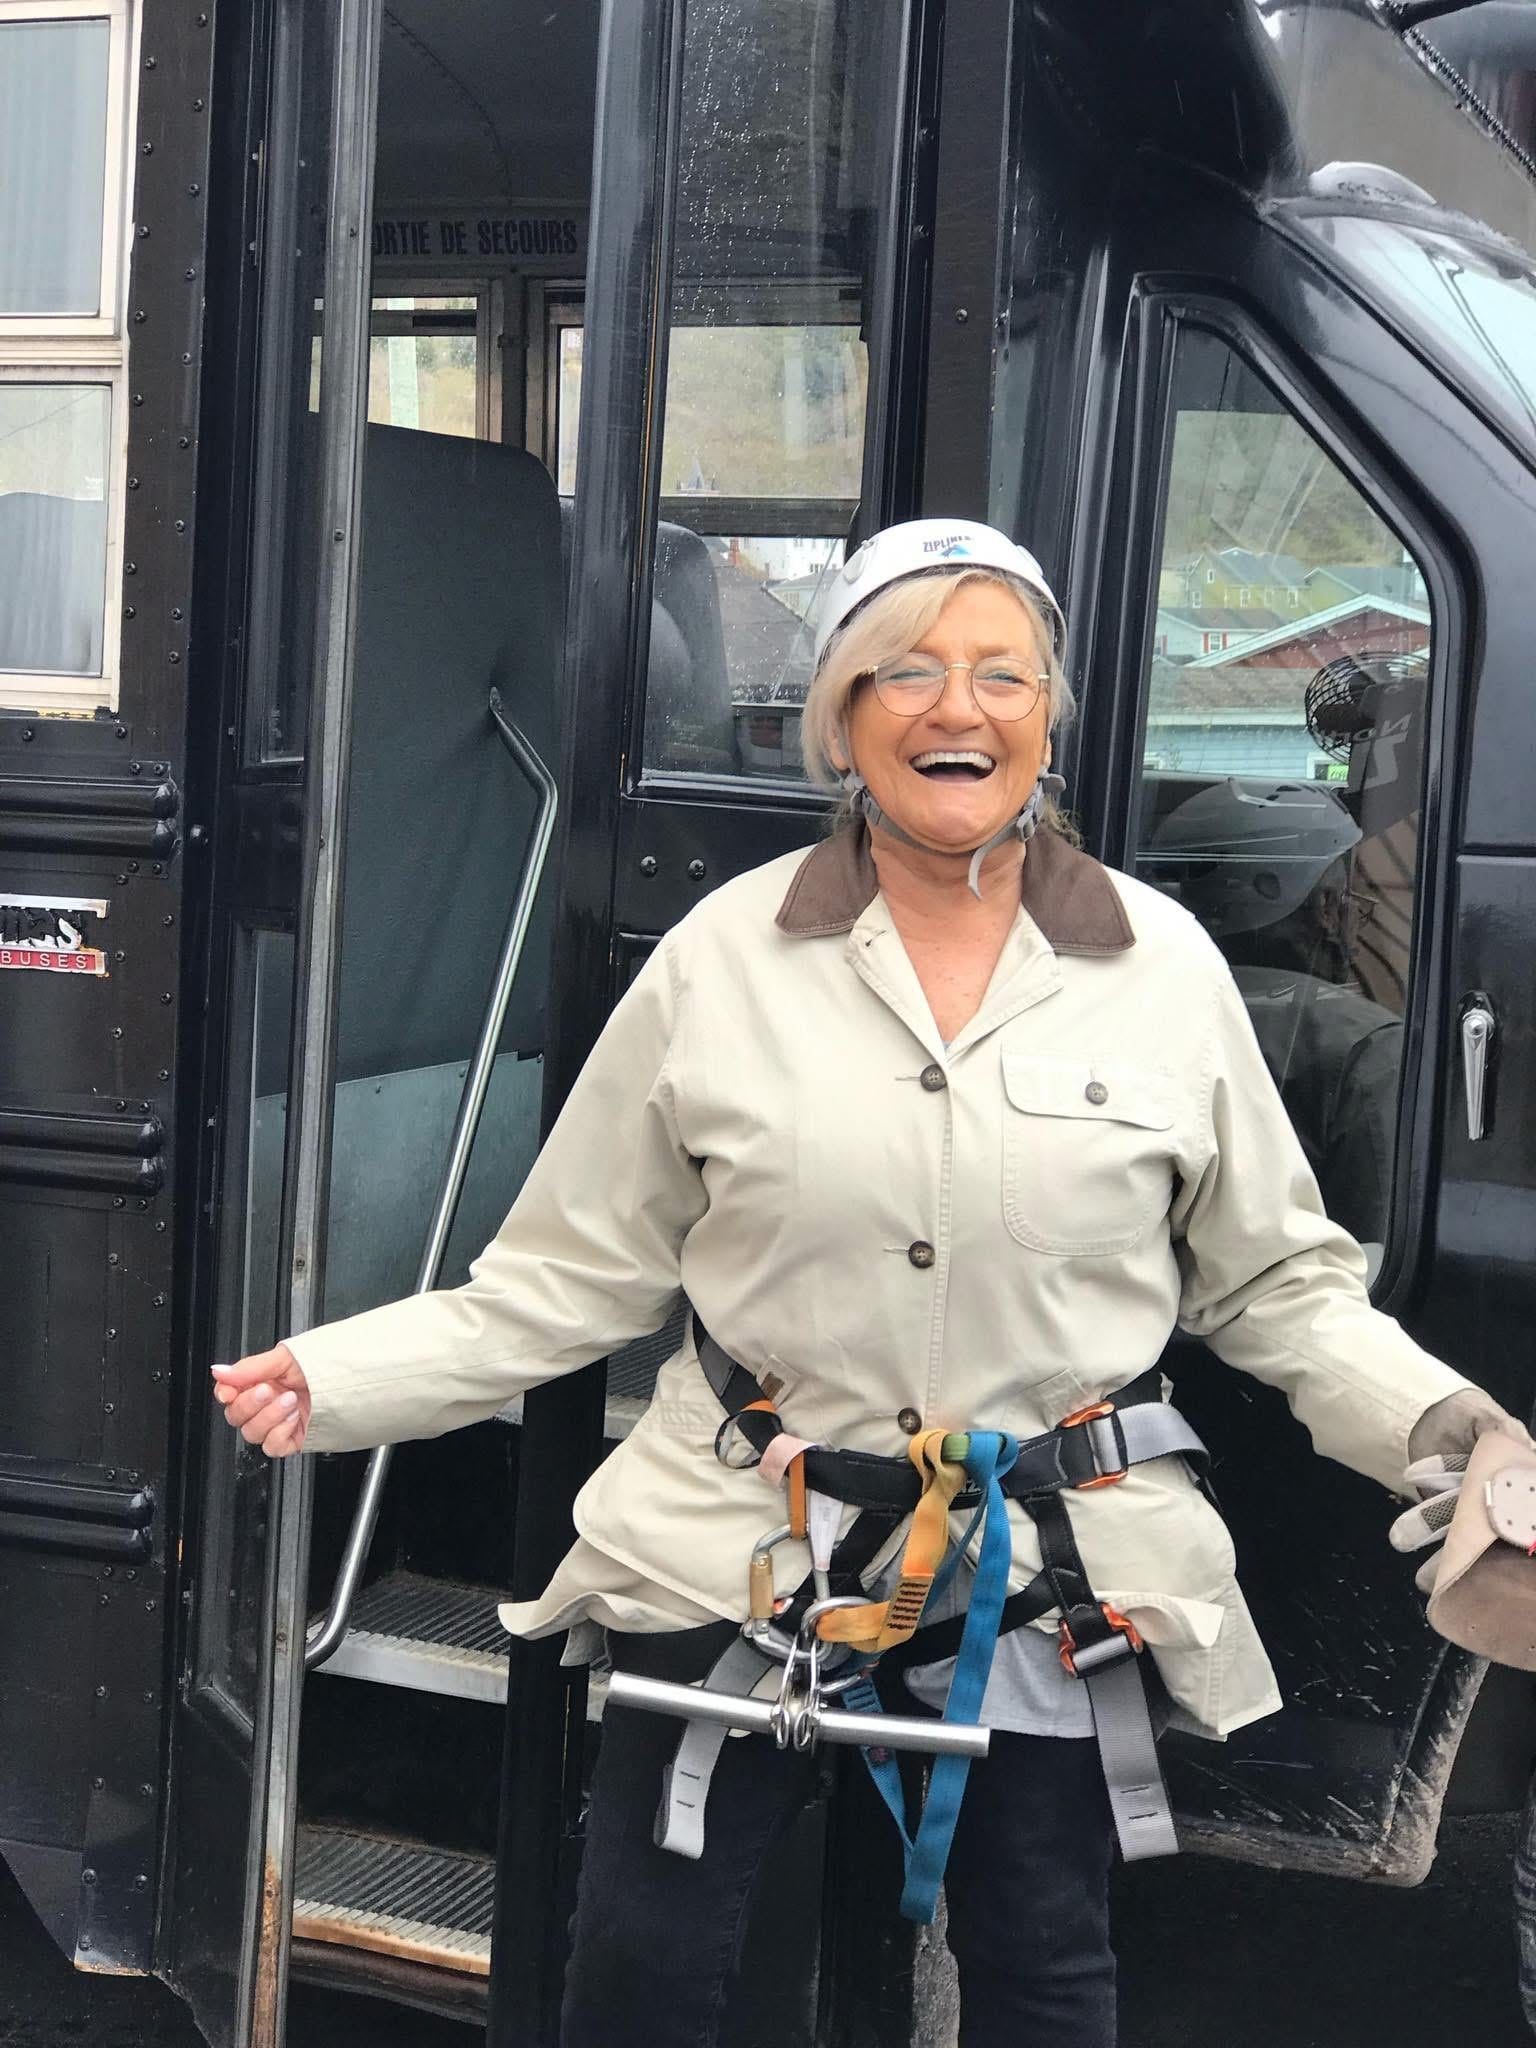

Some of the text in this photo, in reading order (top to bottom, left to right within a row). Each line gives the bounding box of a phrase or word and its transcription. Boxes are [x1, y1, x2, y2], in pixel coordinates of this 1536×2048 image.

[440, 220, 467, 255] DE
[477, 219, 578, 255] SECOURS
[1, 951, 87, 969] BUSES
